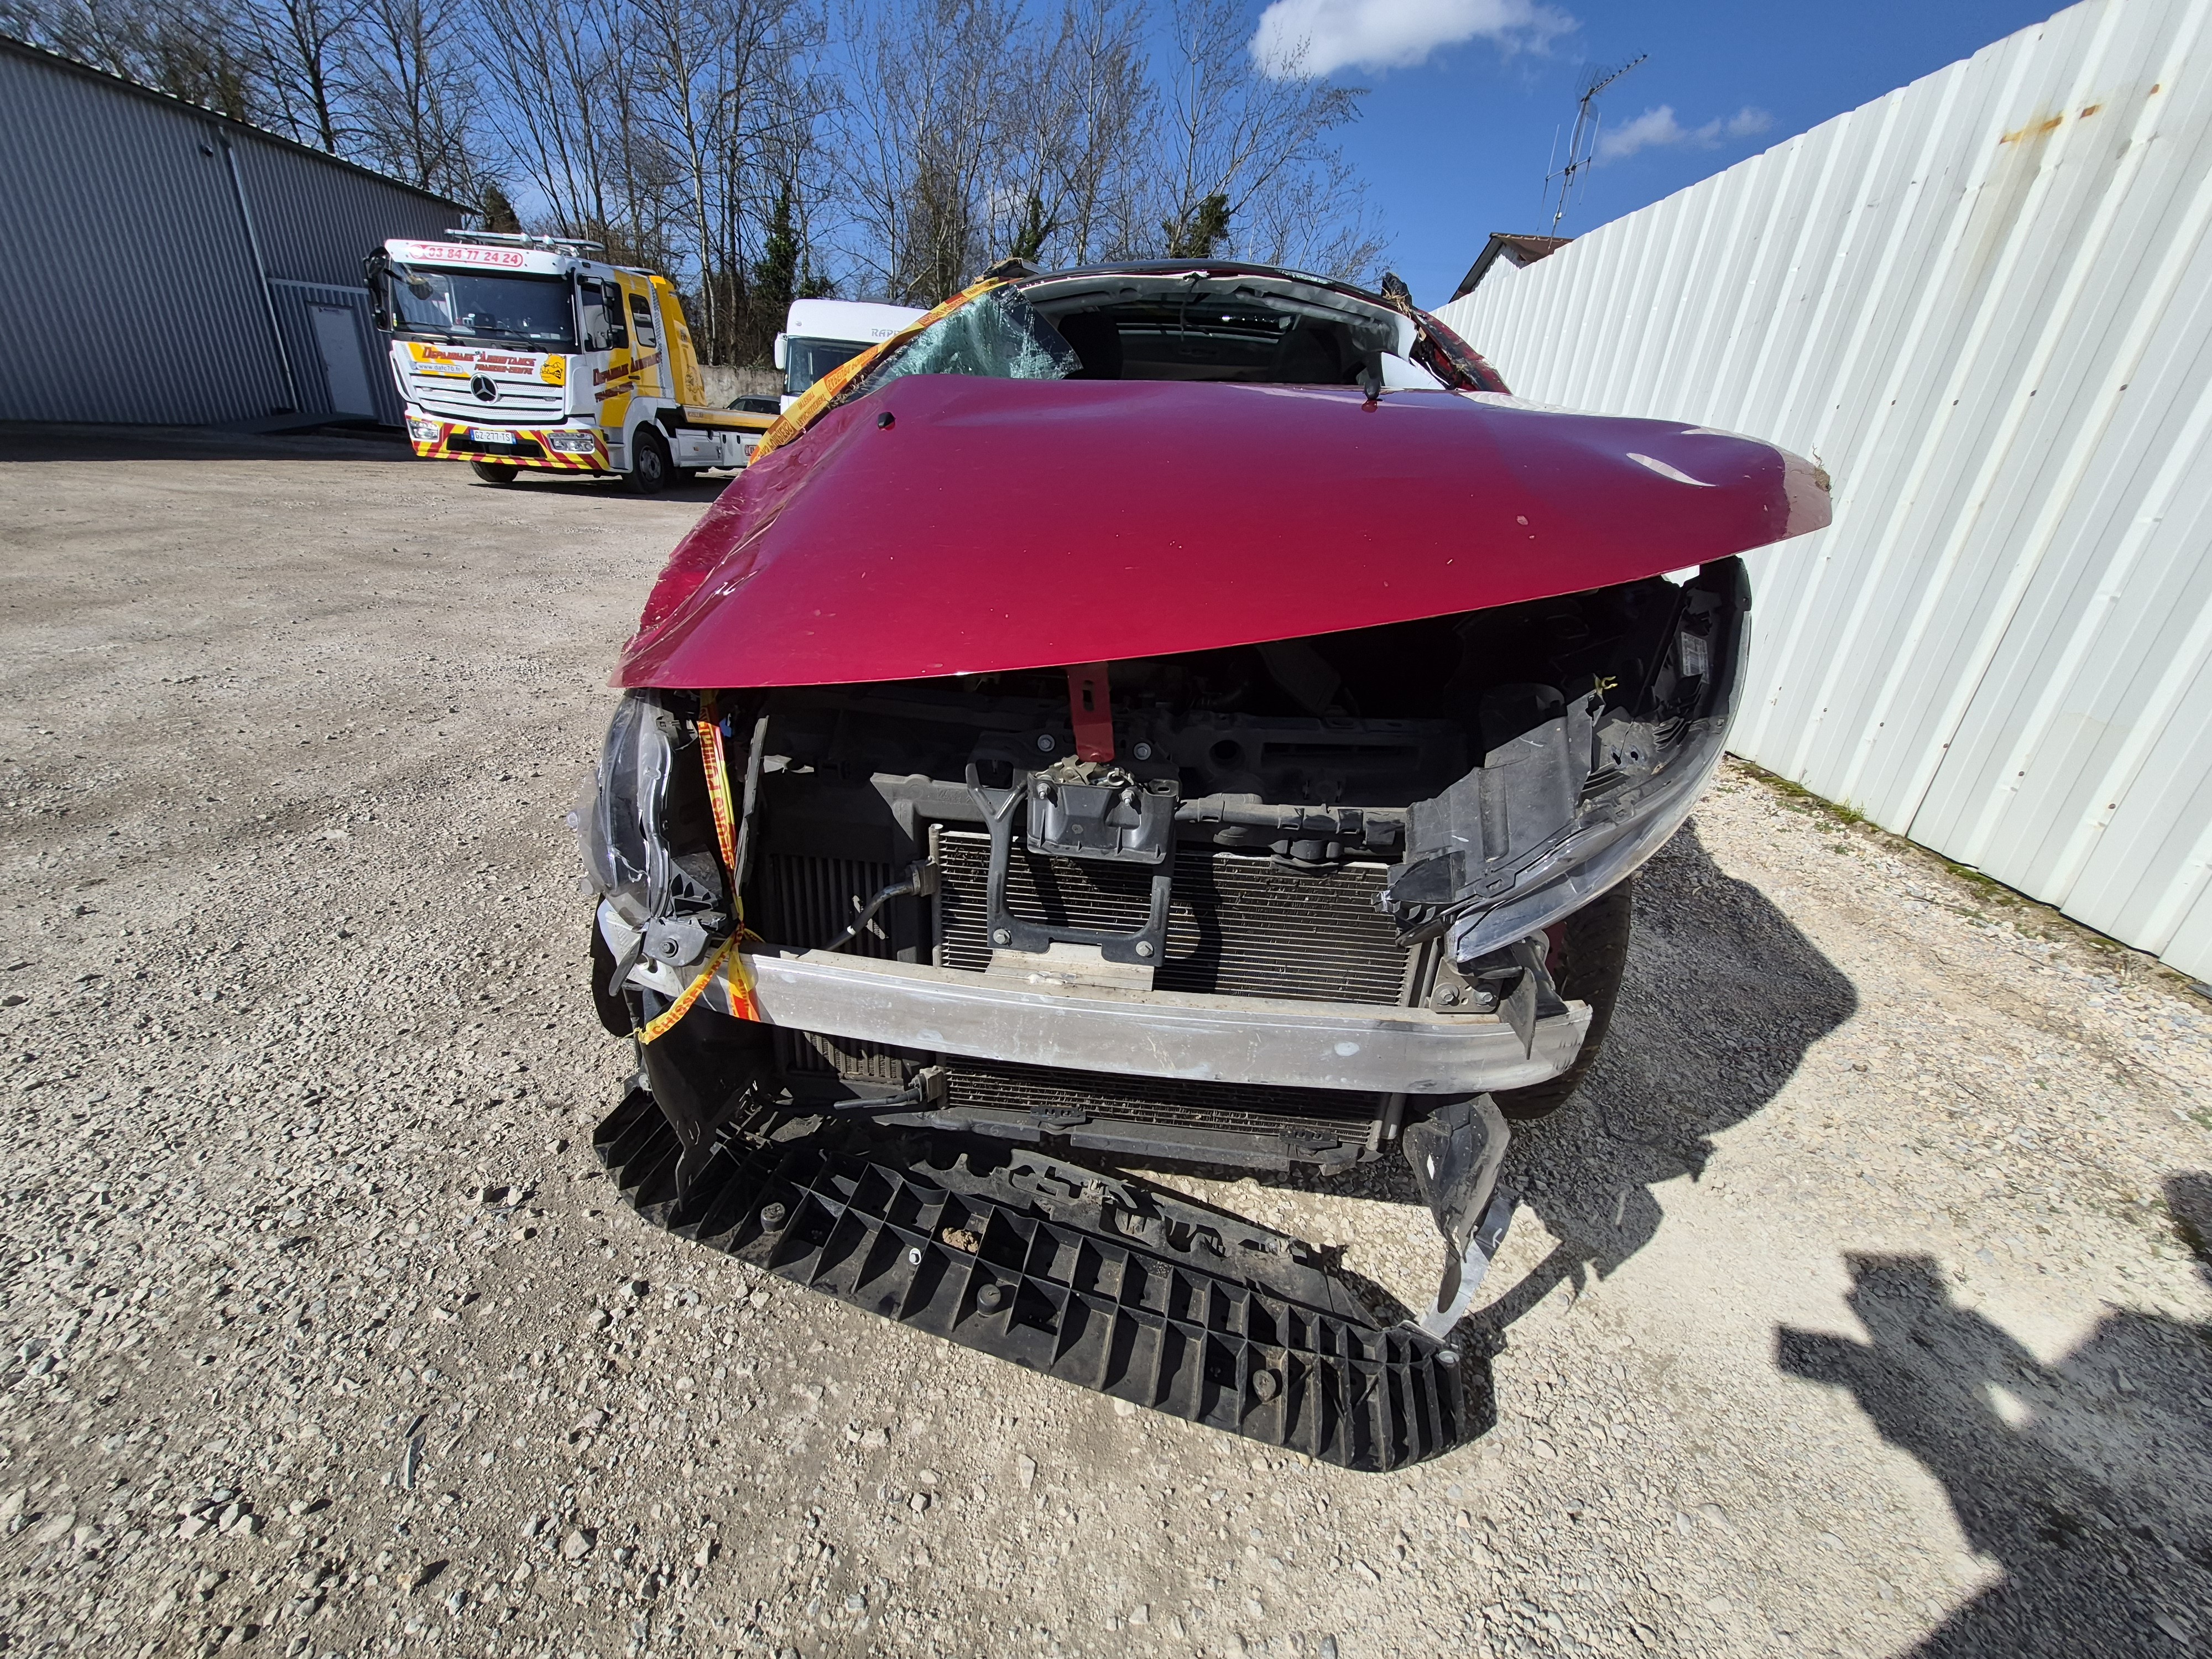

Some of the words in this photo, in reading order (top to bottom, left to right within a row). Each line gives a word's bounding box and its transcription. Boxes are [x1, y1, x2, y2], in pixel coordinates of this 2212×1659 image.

[429, 247, 443, 257] 03
[447, 249, 462, 259] 84
[466, 251, 479, 260] 77
[484, 252, 498, 262] 24
[503, 254, 518, 264] 24
[475, 431, 510, 441] GZ-277-TS
[651, 951, 726, 1036] CHISSEMENT
